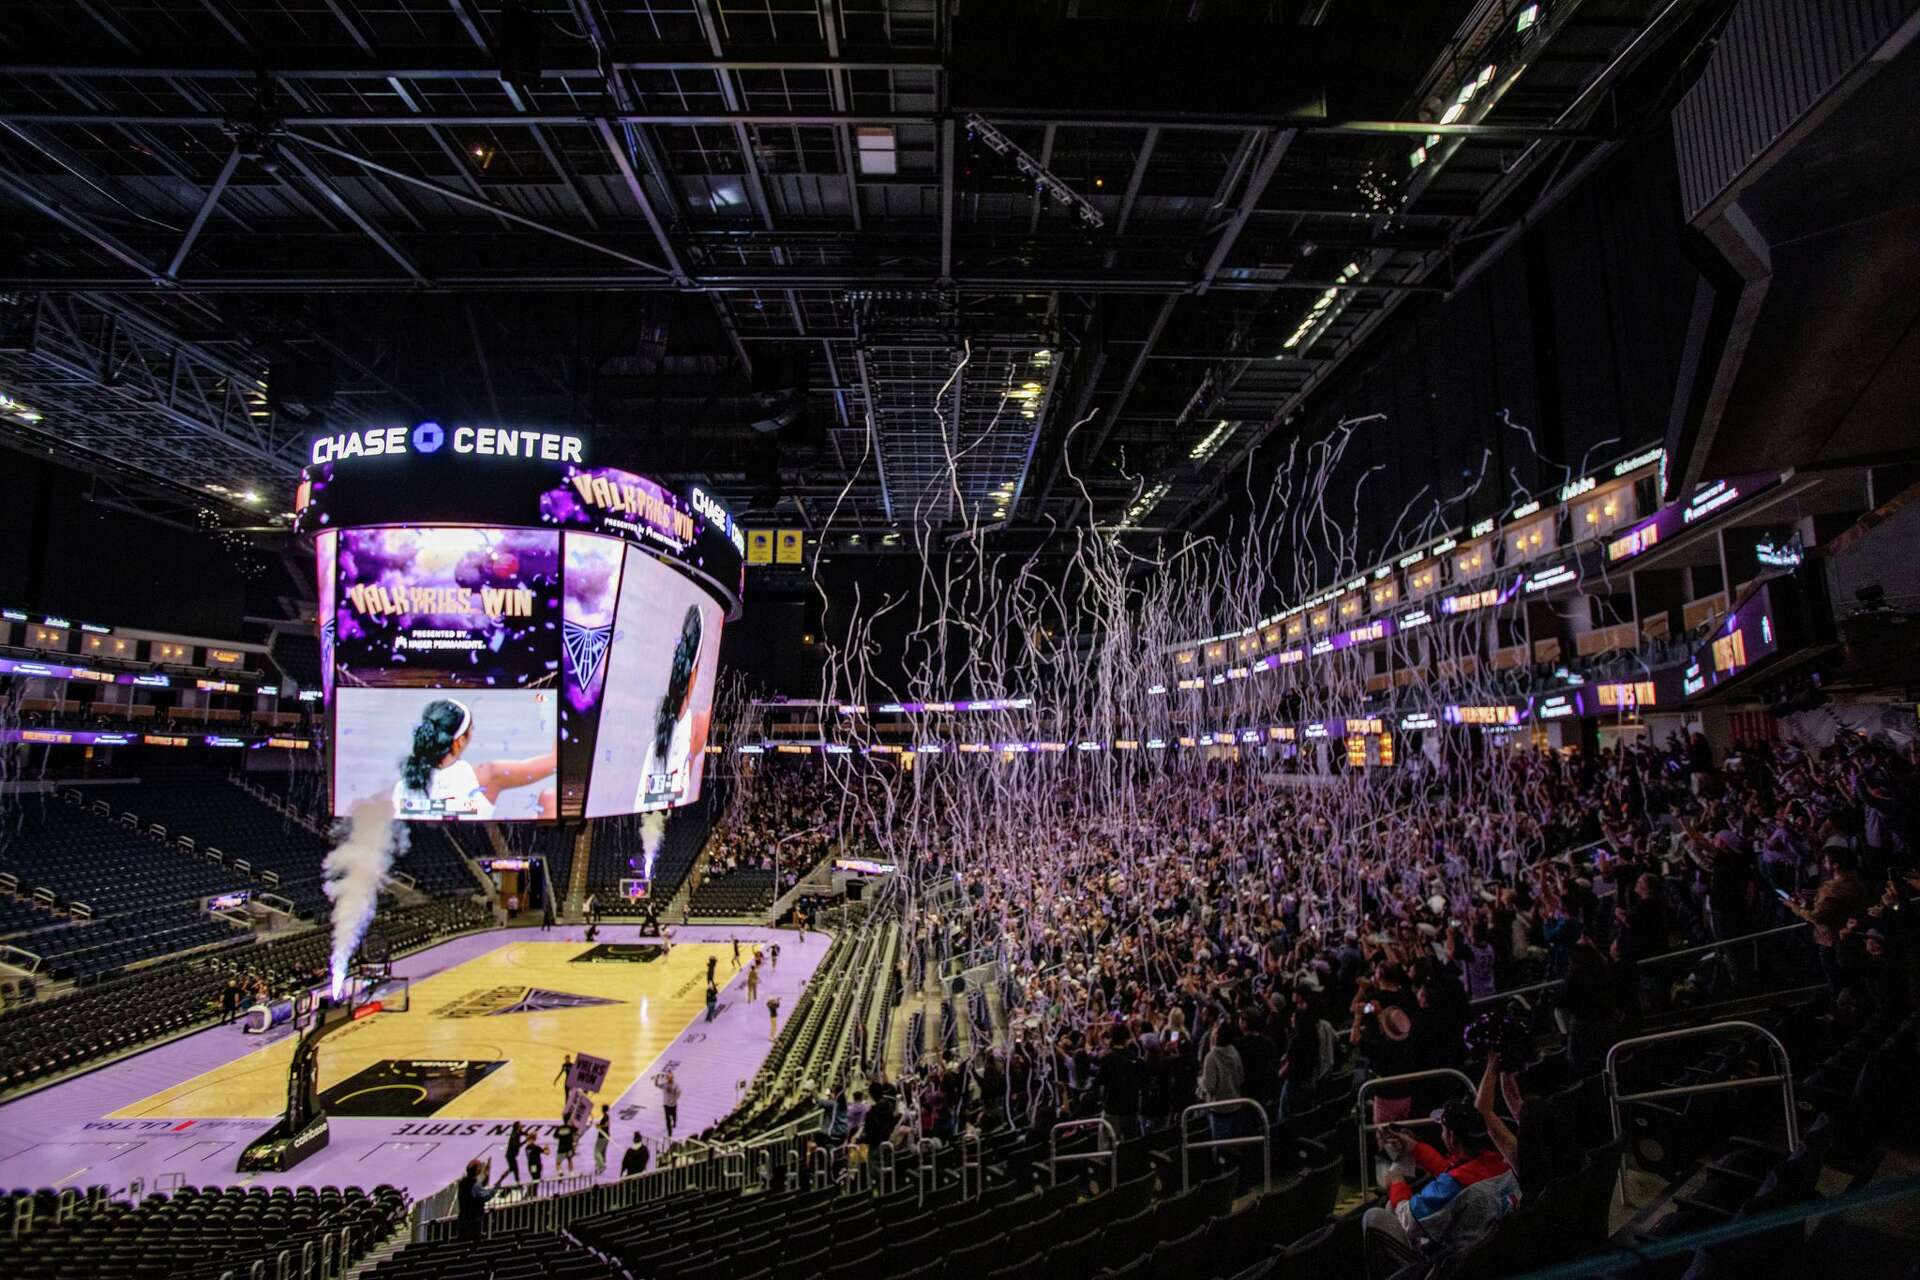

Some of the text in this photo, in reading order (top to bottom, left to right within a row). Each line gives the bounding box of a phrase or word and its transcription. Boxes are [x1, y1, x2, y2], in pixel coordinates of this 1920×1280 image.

[313, 427, 582, 464] CHASE CENTER
[571, 473, 671, 530] VALKYRIES
[673, 509, 694, 542] WIN
[692, 487, 727, 532] CHASE
[350, 583, 532, 617] VALKYRIES WIN
[412, 630, 456, 638] PRESENTED
[83, 1121, 173, 1131] ULTRA
[293, 1122, 329, 1148] coinbase
[391, 1123, 483, 1136] STATE
